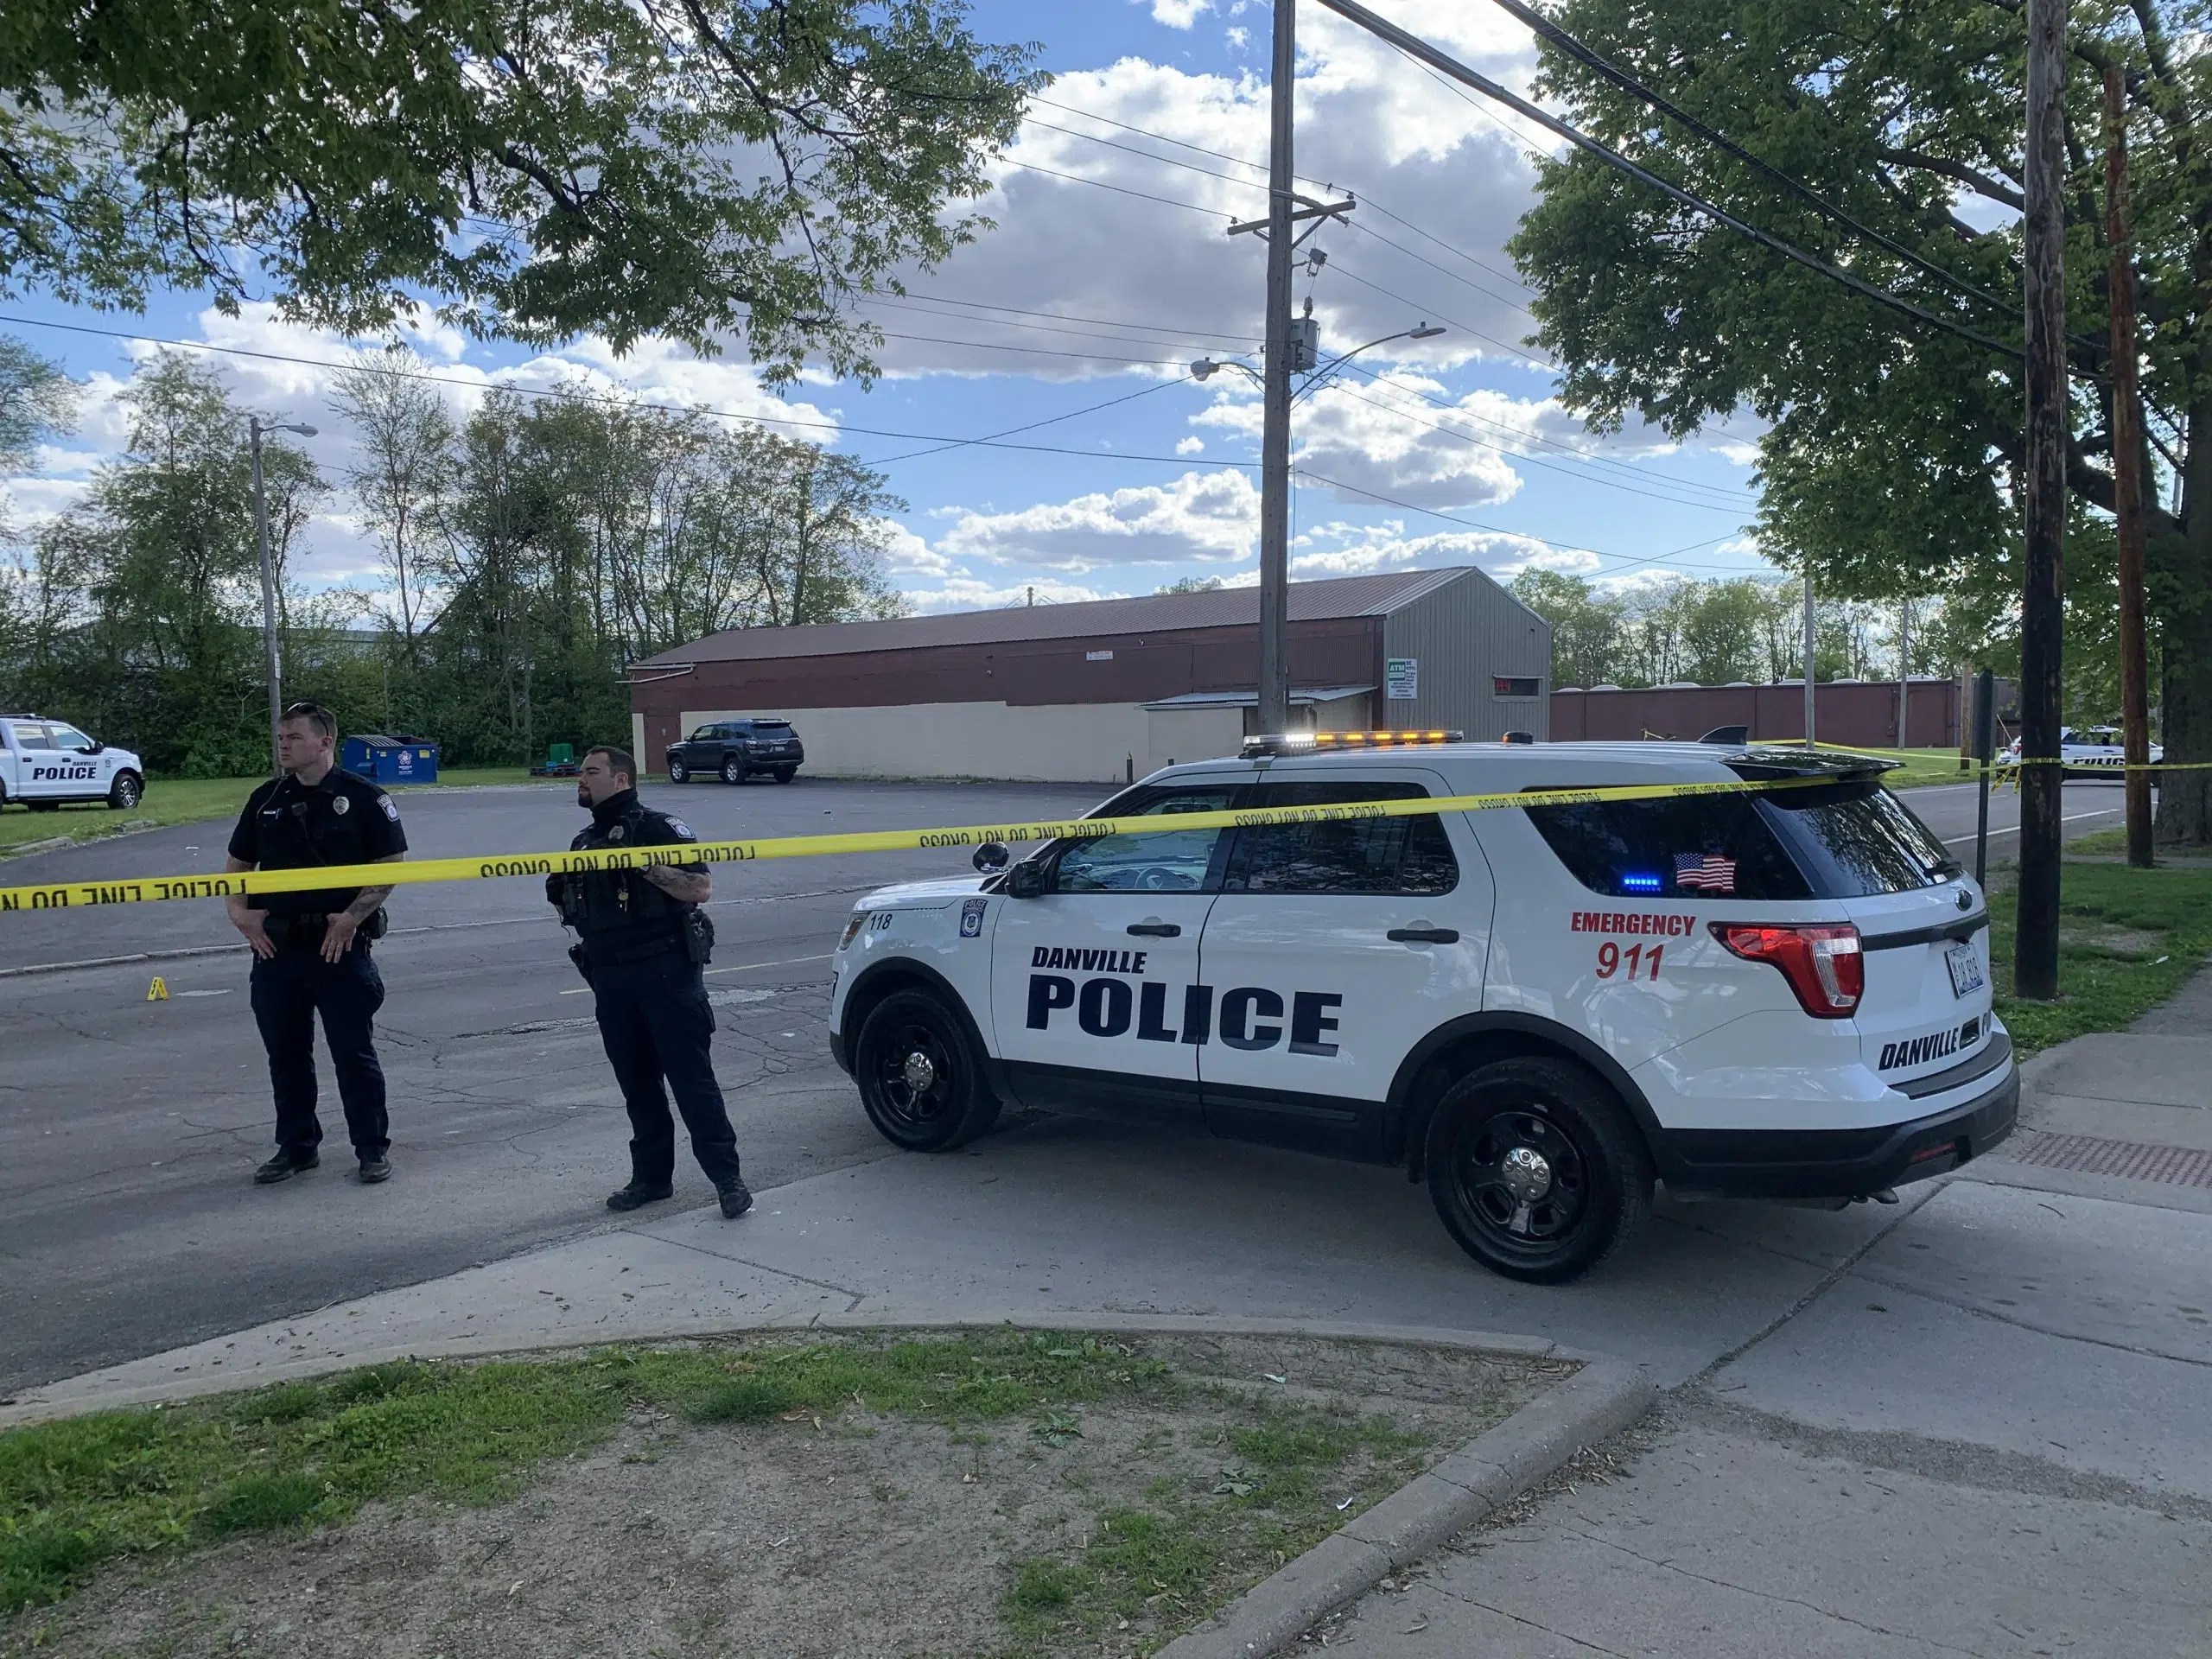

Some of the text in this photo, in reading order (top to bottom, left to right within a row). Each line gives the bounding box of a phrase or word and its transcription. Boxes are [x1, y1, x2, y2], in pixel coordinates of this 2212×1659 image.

[33, 767, 97, 780] POLICE
[964, 899, 988, 908] POLICE
[870, 913, 893, 931] 118
[1571, 912, 1697, 937] EMERGENCY
[1032, 946, 1147, 975] DANVILLE
[1595, 941, 1665, 982] 911
[1026, 974, 1343, 1058] POLICE
[1878, 1027, 1959, 1071] DANVILLE
